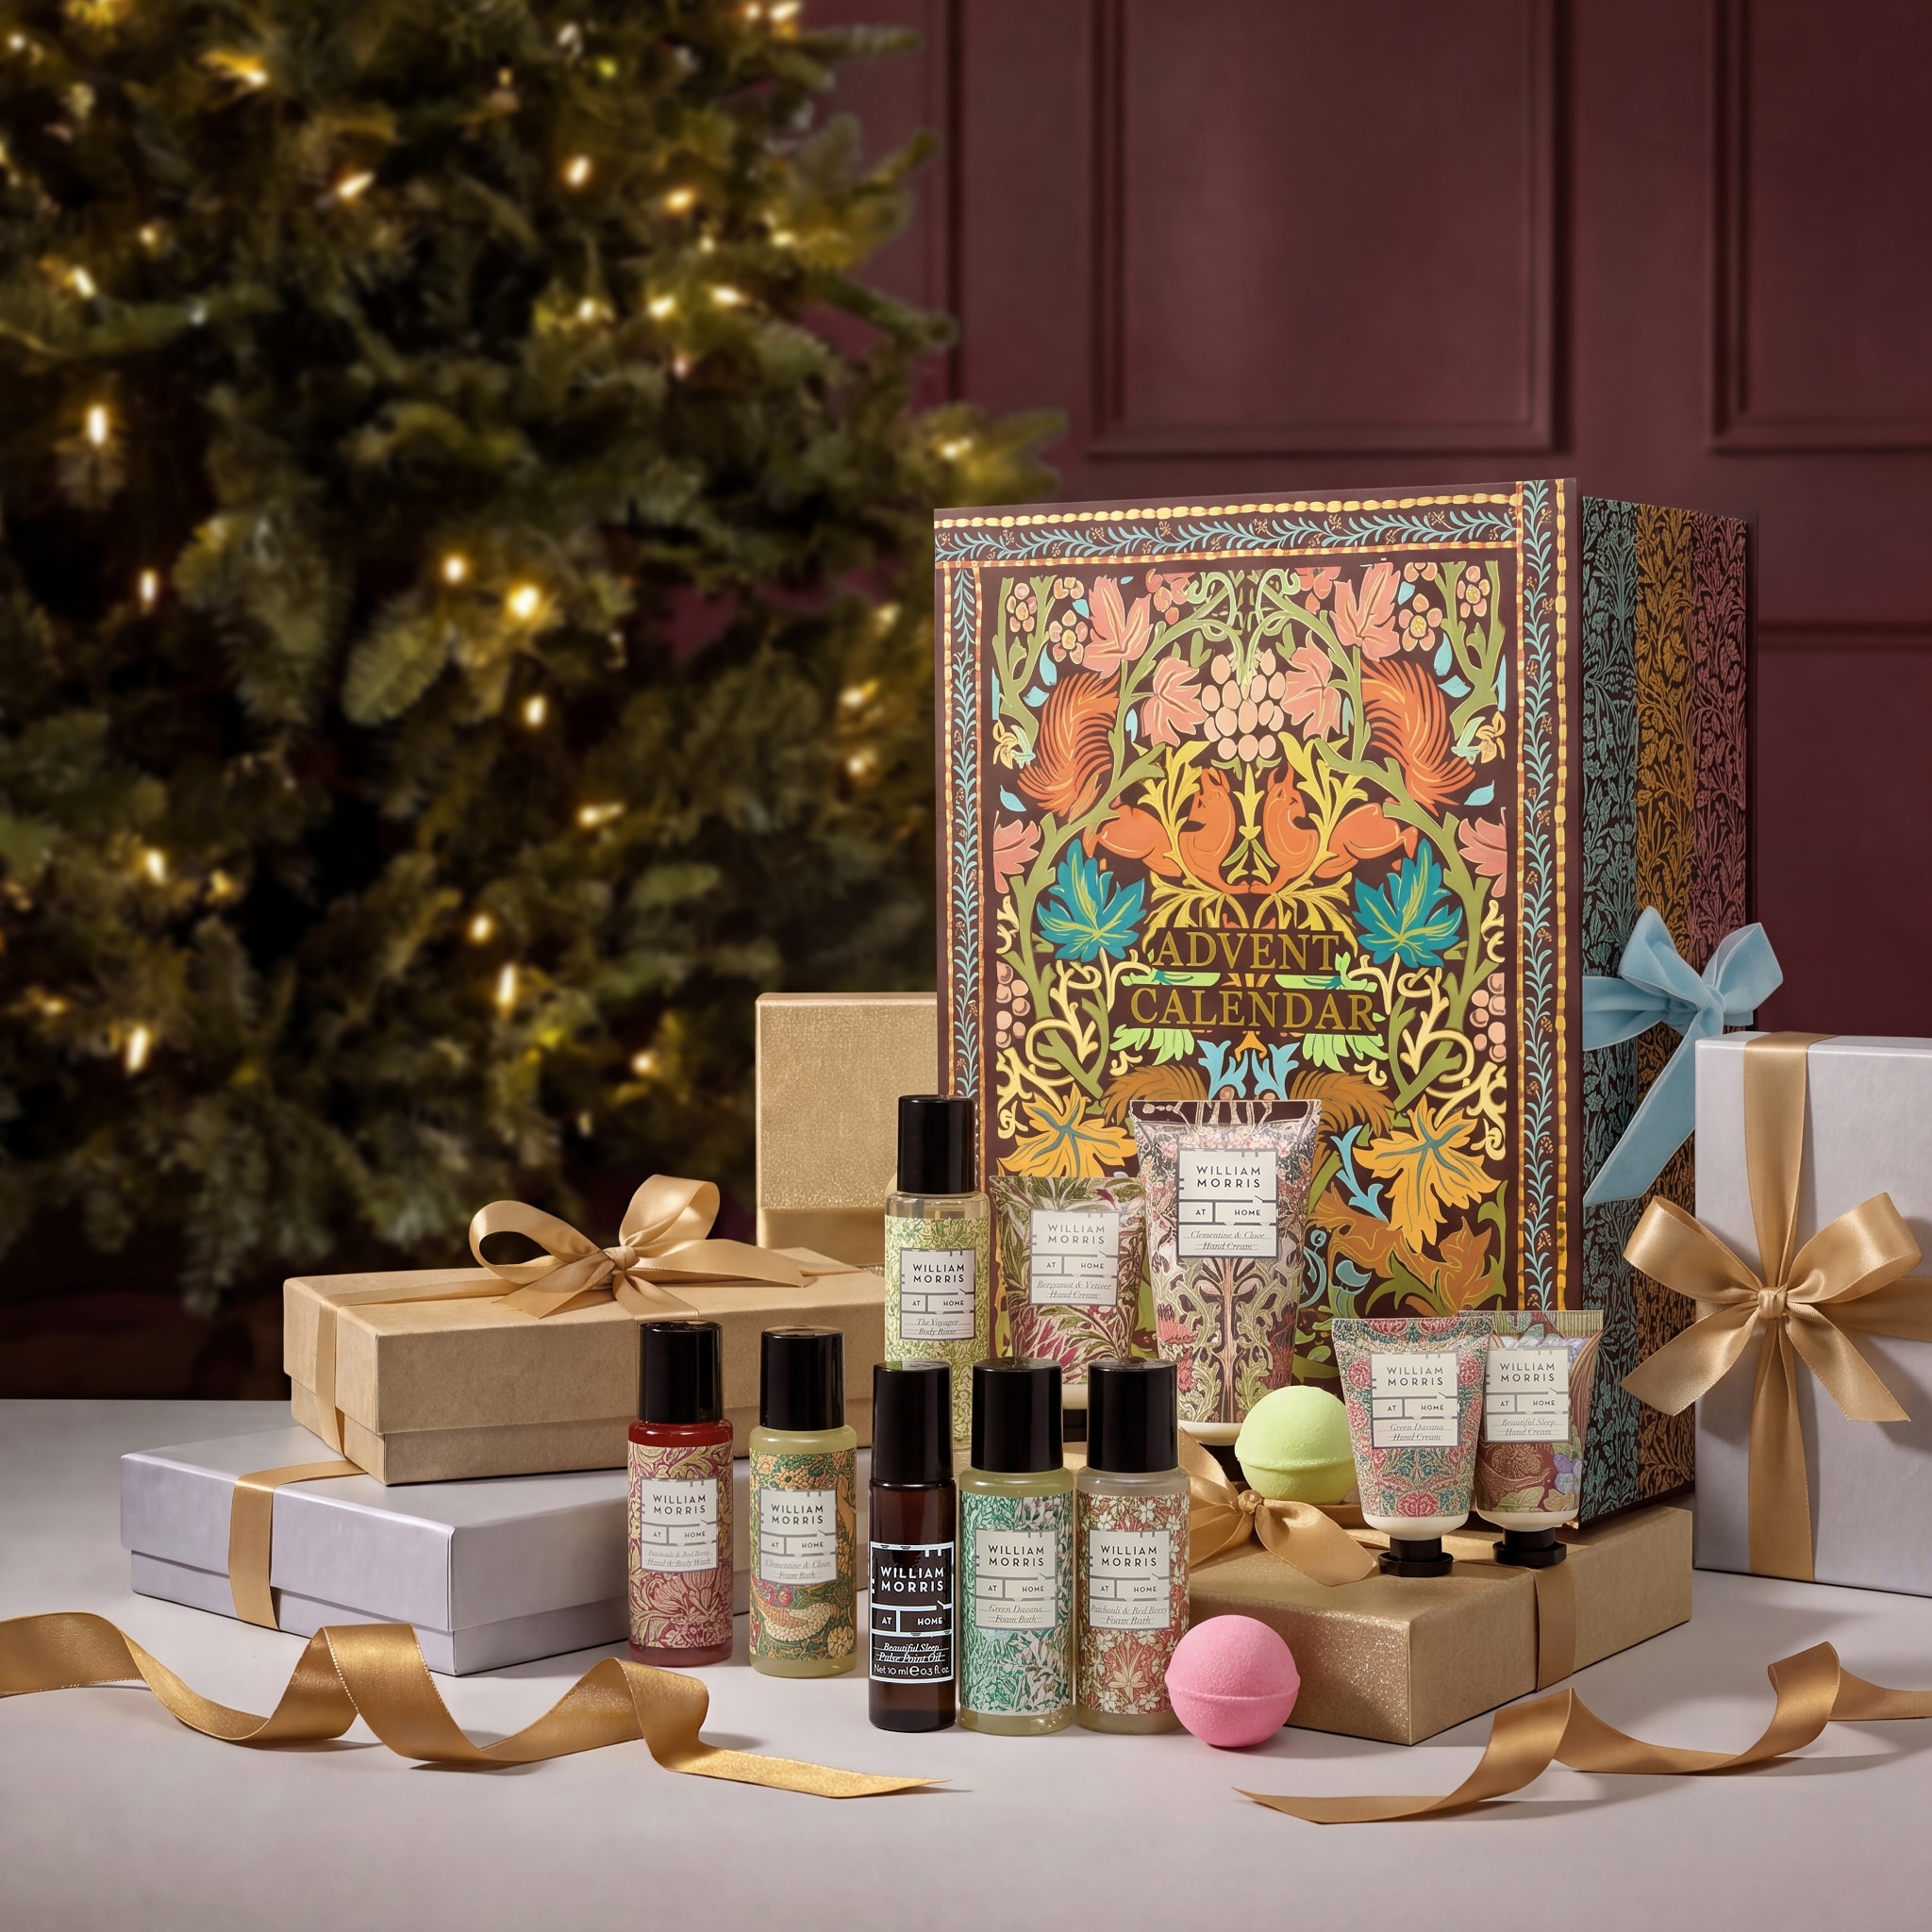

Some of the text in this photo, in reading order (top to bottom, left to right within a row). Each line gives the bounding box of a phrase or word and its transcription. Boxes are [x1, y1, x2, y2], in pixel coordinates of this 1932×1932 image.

[1152, 930, 1340, 971] ADVENT
[1131, 988, 1376, 1031] CALENDAR
[1196, 1166, 1260, 1174] WILLIAM
[1197, 1178, 1260, 1188] MORRIS
[1048, 1224, 1105, 1233] WILLIAM
[1048, 1236, 1104, 1244] MORRIS
[913, 1274, 964, 1283] MORRIS
[1037, 1281, 1074, 1290] Bergamot
[1086, 1281, 1111, 1290] Vetiver
[932, 1319, 958, 1327] Voyager
[1389, 1377, 1442, 1386] MORRIS
[1501, 1374, 1554, 1382] MORRIS
[1502, 1419, 1556, 1427] Beautiful Sleep
[653, 1494, 706, 1504] WILLIAM
[654, 1506, 706, 1515] MORRIS
[772, 1504, 823, 1513] WILLIAM
[772, 1516, 823, 1524] MORRIS
[989, 1545, 1043, 1555] WILLIAM
[1101, 1545, 1157, 1555] WILLIAM
[766, 1559, 802, 1569] Clementine
[990, 1557, 1043, 1566] MORRIS
[779, 1571, 797, 1579] Foam
[881, 1566, 943, 1578] WILLIAM
[881, 1580, 943, 1592] MORRIS
[1091, 1605, 1120, 1613] Patchouli
[1149, 1607, 1167, 1615] Berry
[918, 1617, 942, 1625] HOME
[1106, 1615, 1151, 1624] Foam Bath
[884, 1643, 940, 1653] Beautiful Sleep
[878, 1652, 941, 1662] Pulse Point Oil
[874, 1664, 886, 1674] Net
